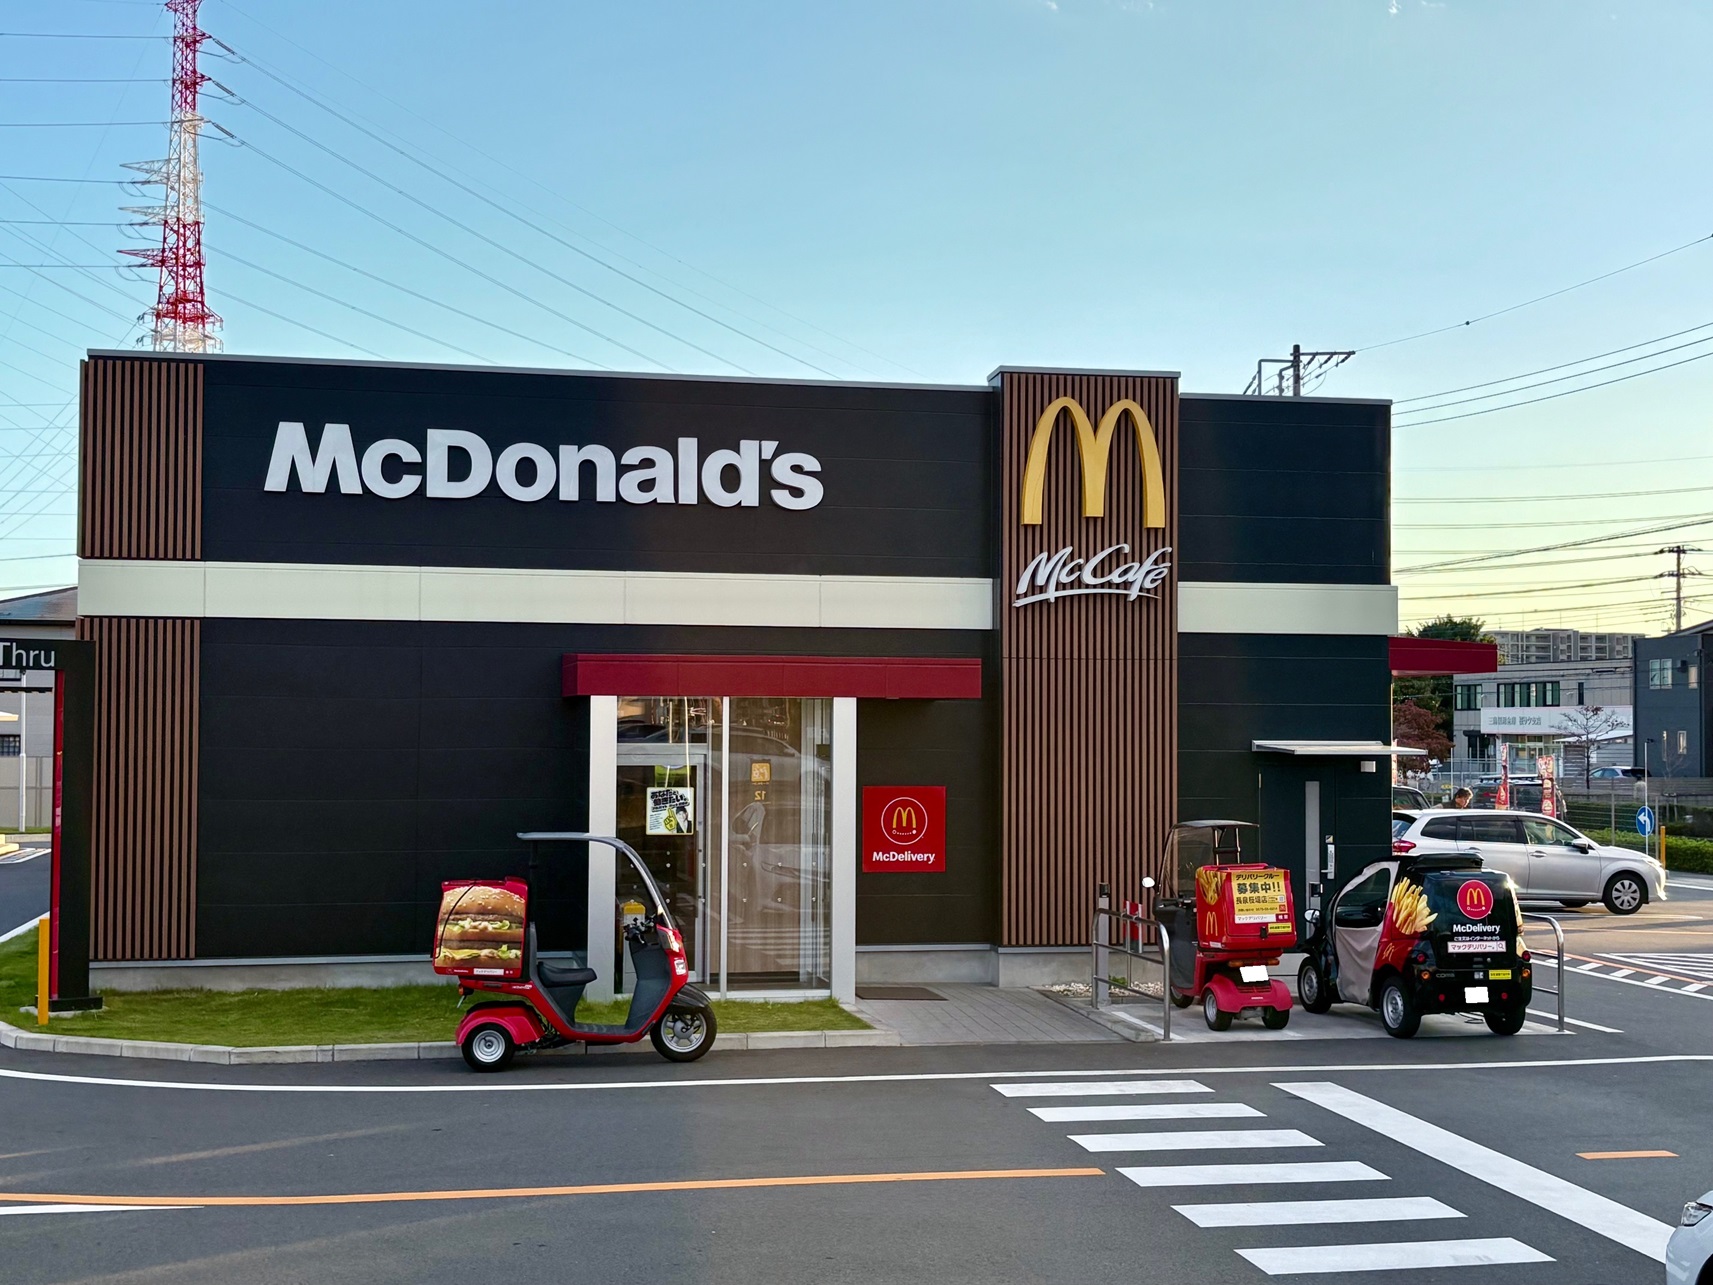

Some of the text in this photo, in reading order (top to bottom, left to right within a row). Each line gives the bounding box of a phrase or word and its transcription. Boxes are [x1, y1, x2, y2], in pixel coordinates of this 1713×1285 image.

[264, 421, 825, 511] McDonald's
[1012, 543, 1172, 607] McCafé
[872, 850, 936, 865] McDelivery
[1453, 923, 1501, 934] McDelivery
